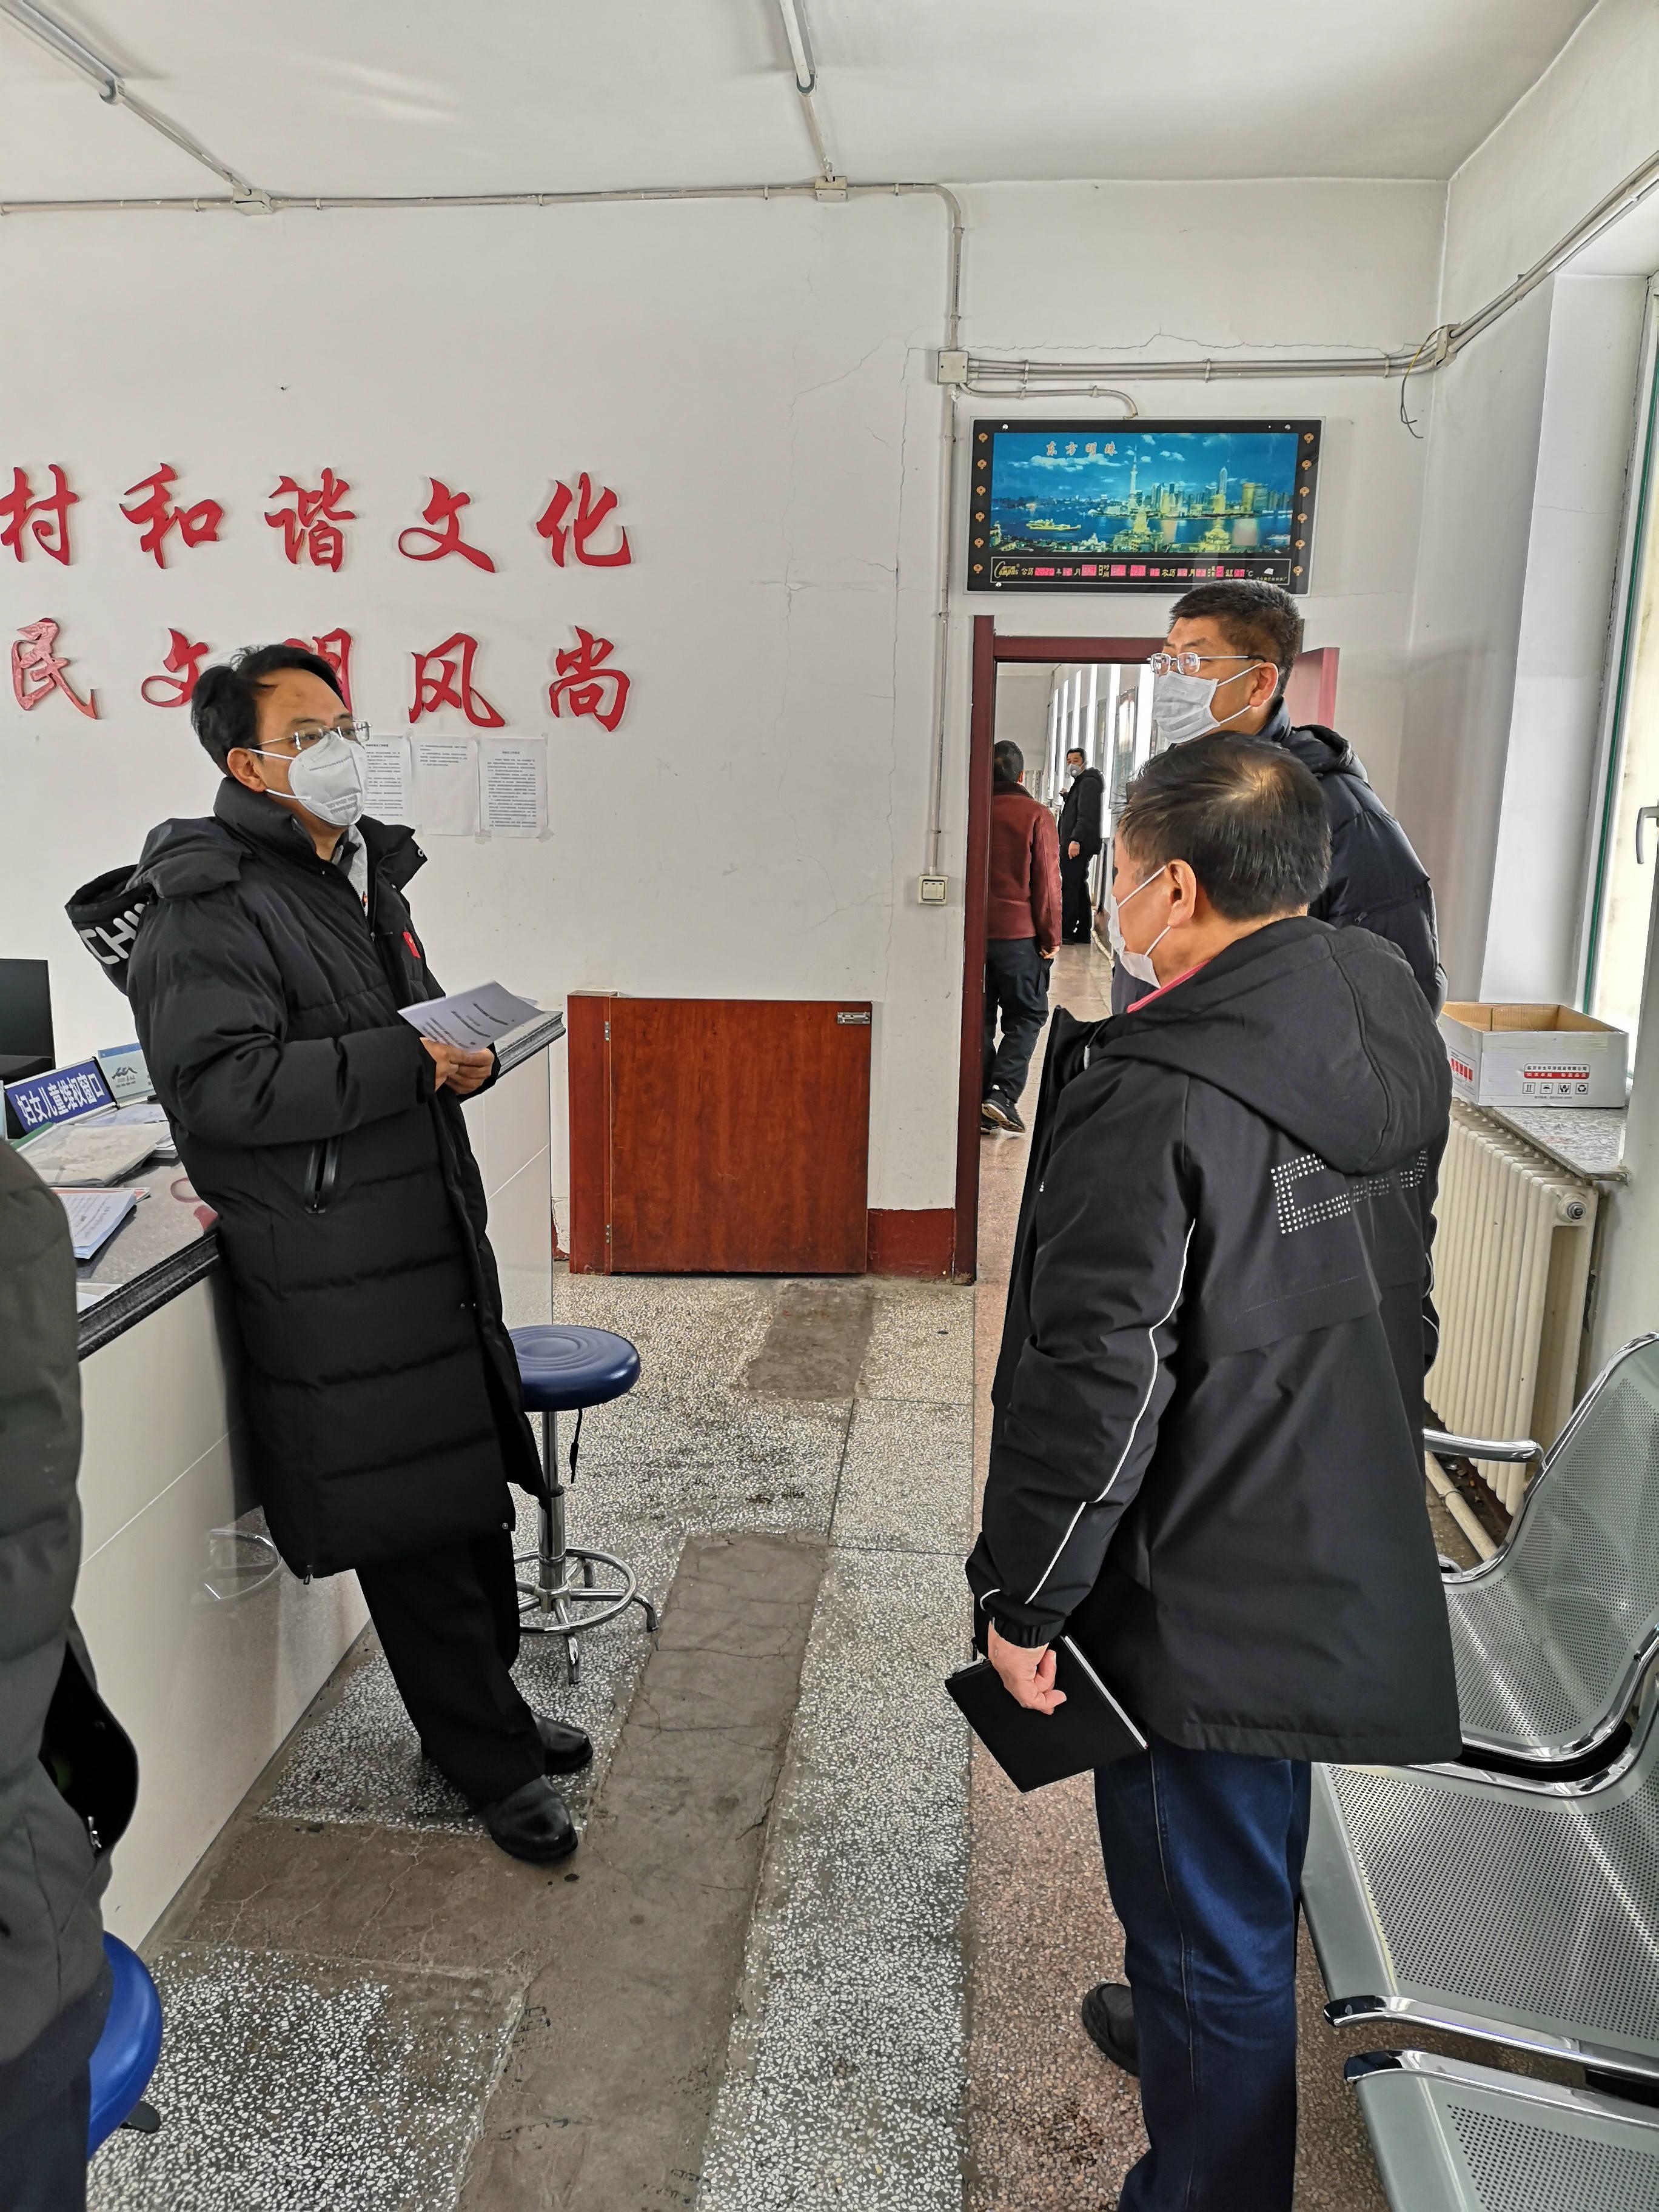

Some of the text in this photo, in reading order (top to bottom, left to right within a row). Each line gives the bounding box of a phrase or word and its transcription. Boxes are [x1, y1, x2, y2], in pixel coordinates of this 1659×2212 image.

[1046, 441, 1118, 456] 东方明珠
[0, 463, 632, 572] 村和谐文化
[15, 1073, 105, 1126] 妇女儿童维权窗口
